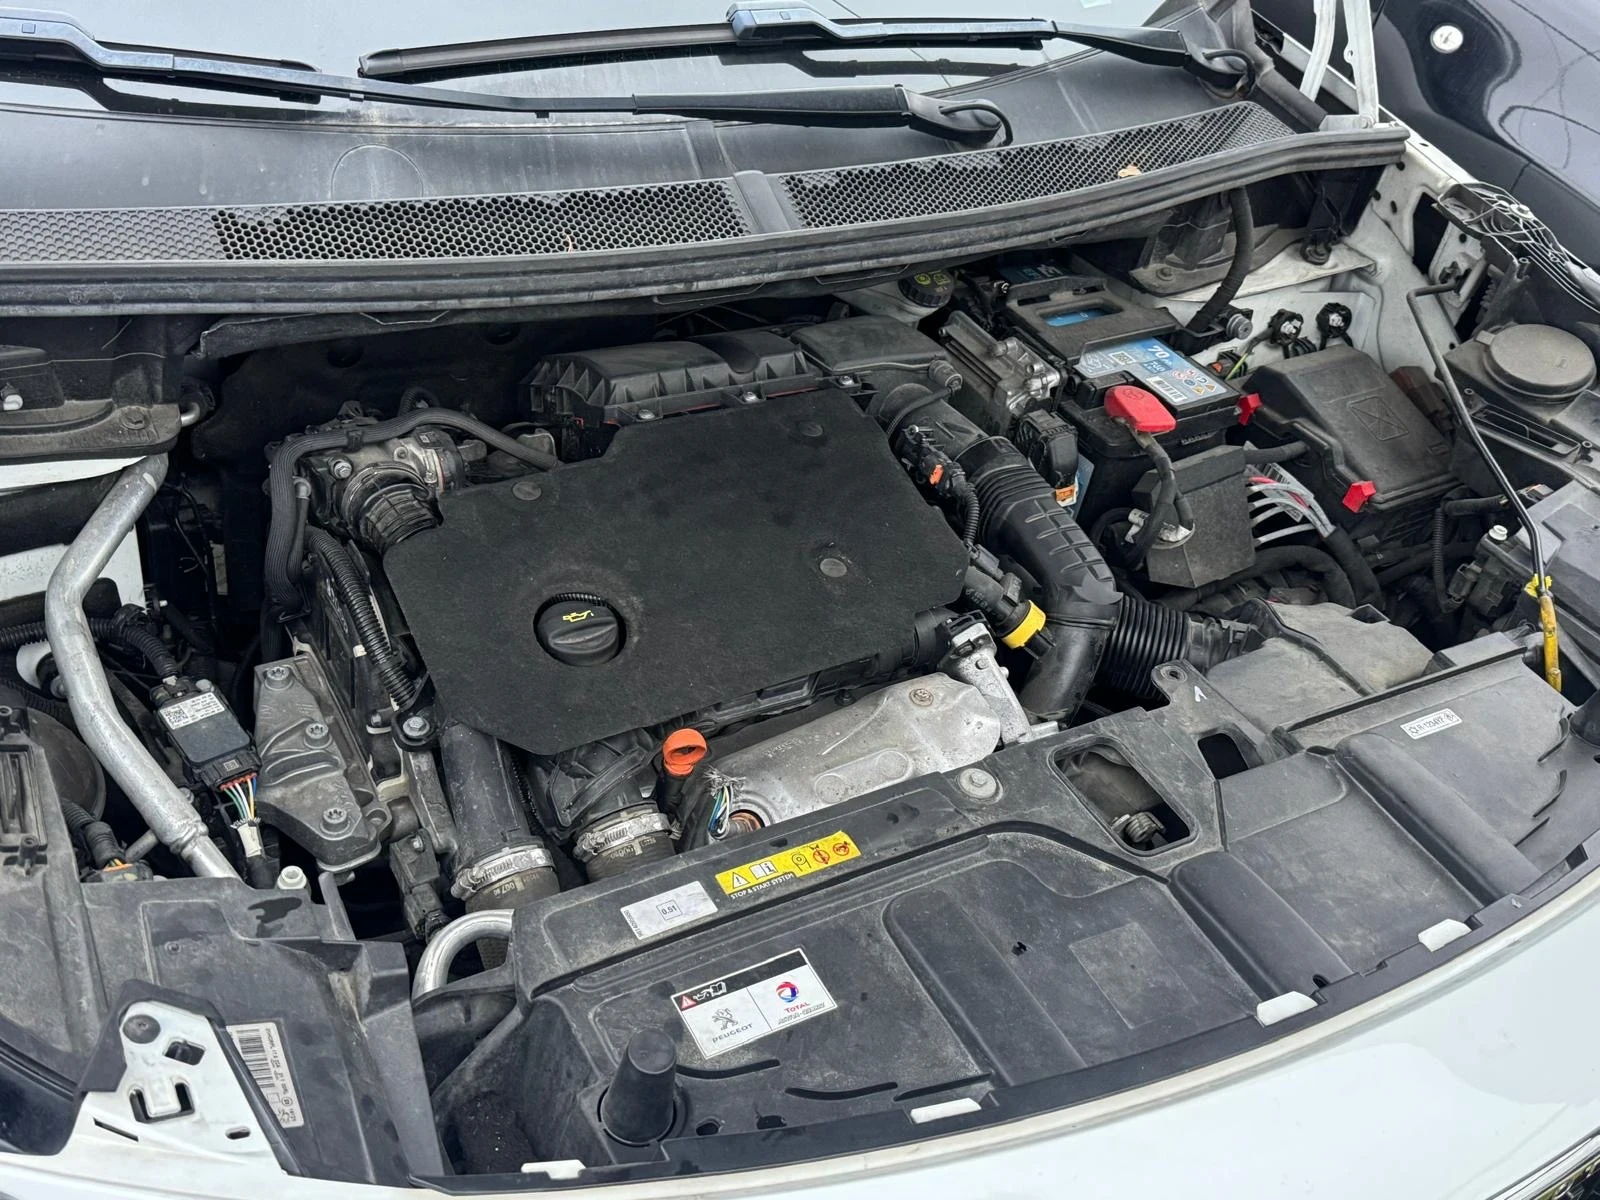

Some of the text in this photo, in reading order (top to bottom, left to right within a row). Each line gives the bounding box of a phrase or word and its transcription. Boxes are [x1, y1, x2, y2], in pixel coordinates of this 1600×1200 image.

[1147, 345, 1170, 359] 70
[730, 889, 747, 900] STOP
[752, 881, 771, 892] START
[771, 872, 795, 886] SYSTEM
[661, 905, 677, 915] 0.51
[784, 1002, 810, 1013] TOTAL
[712, 1023, 753, 1043] PEUGEOT
